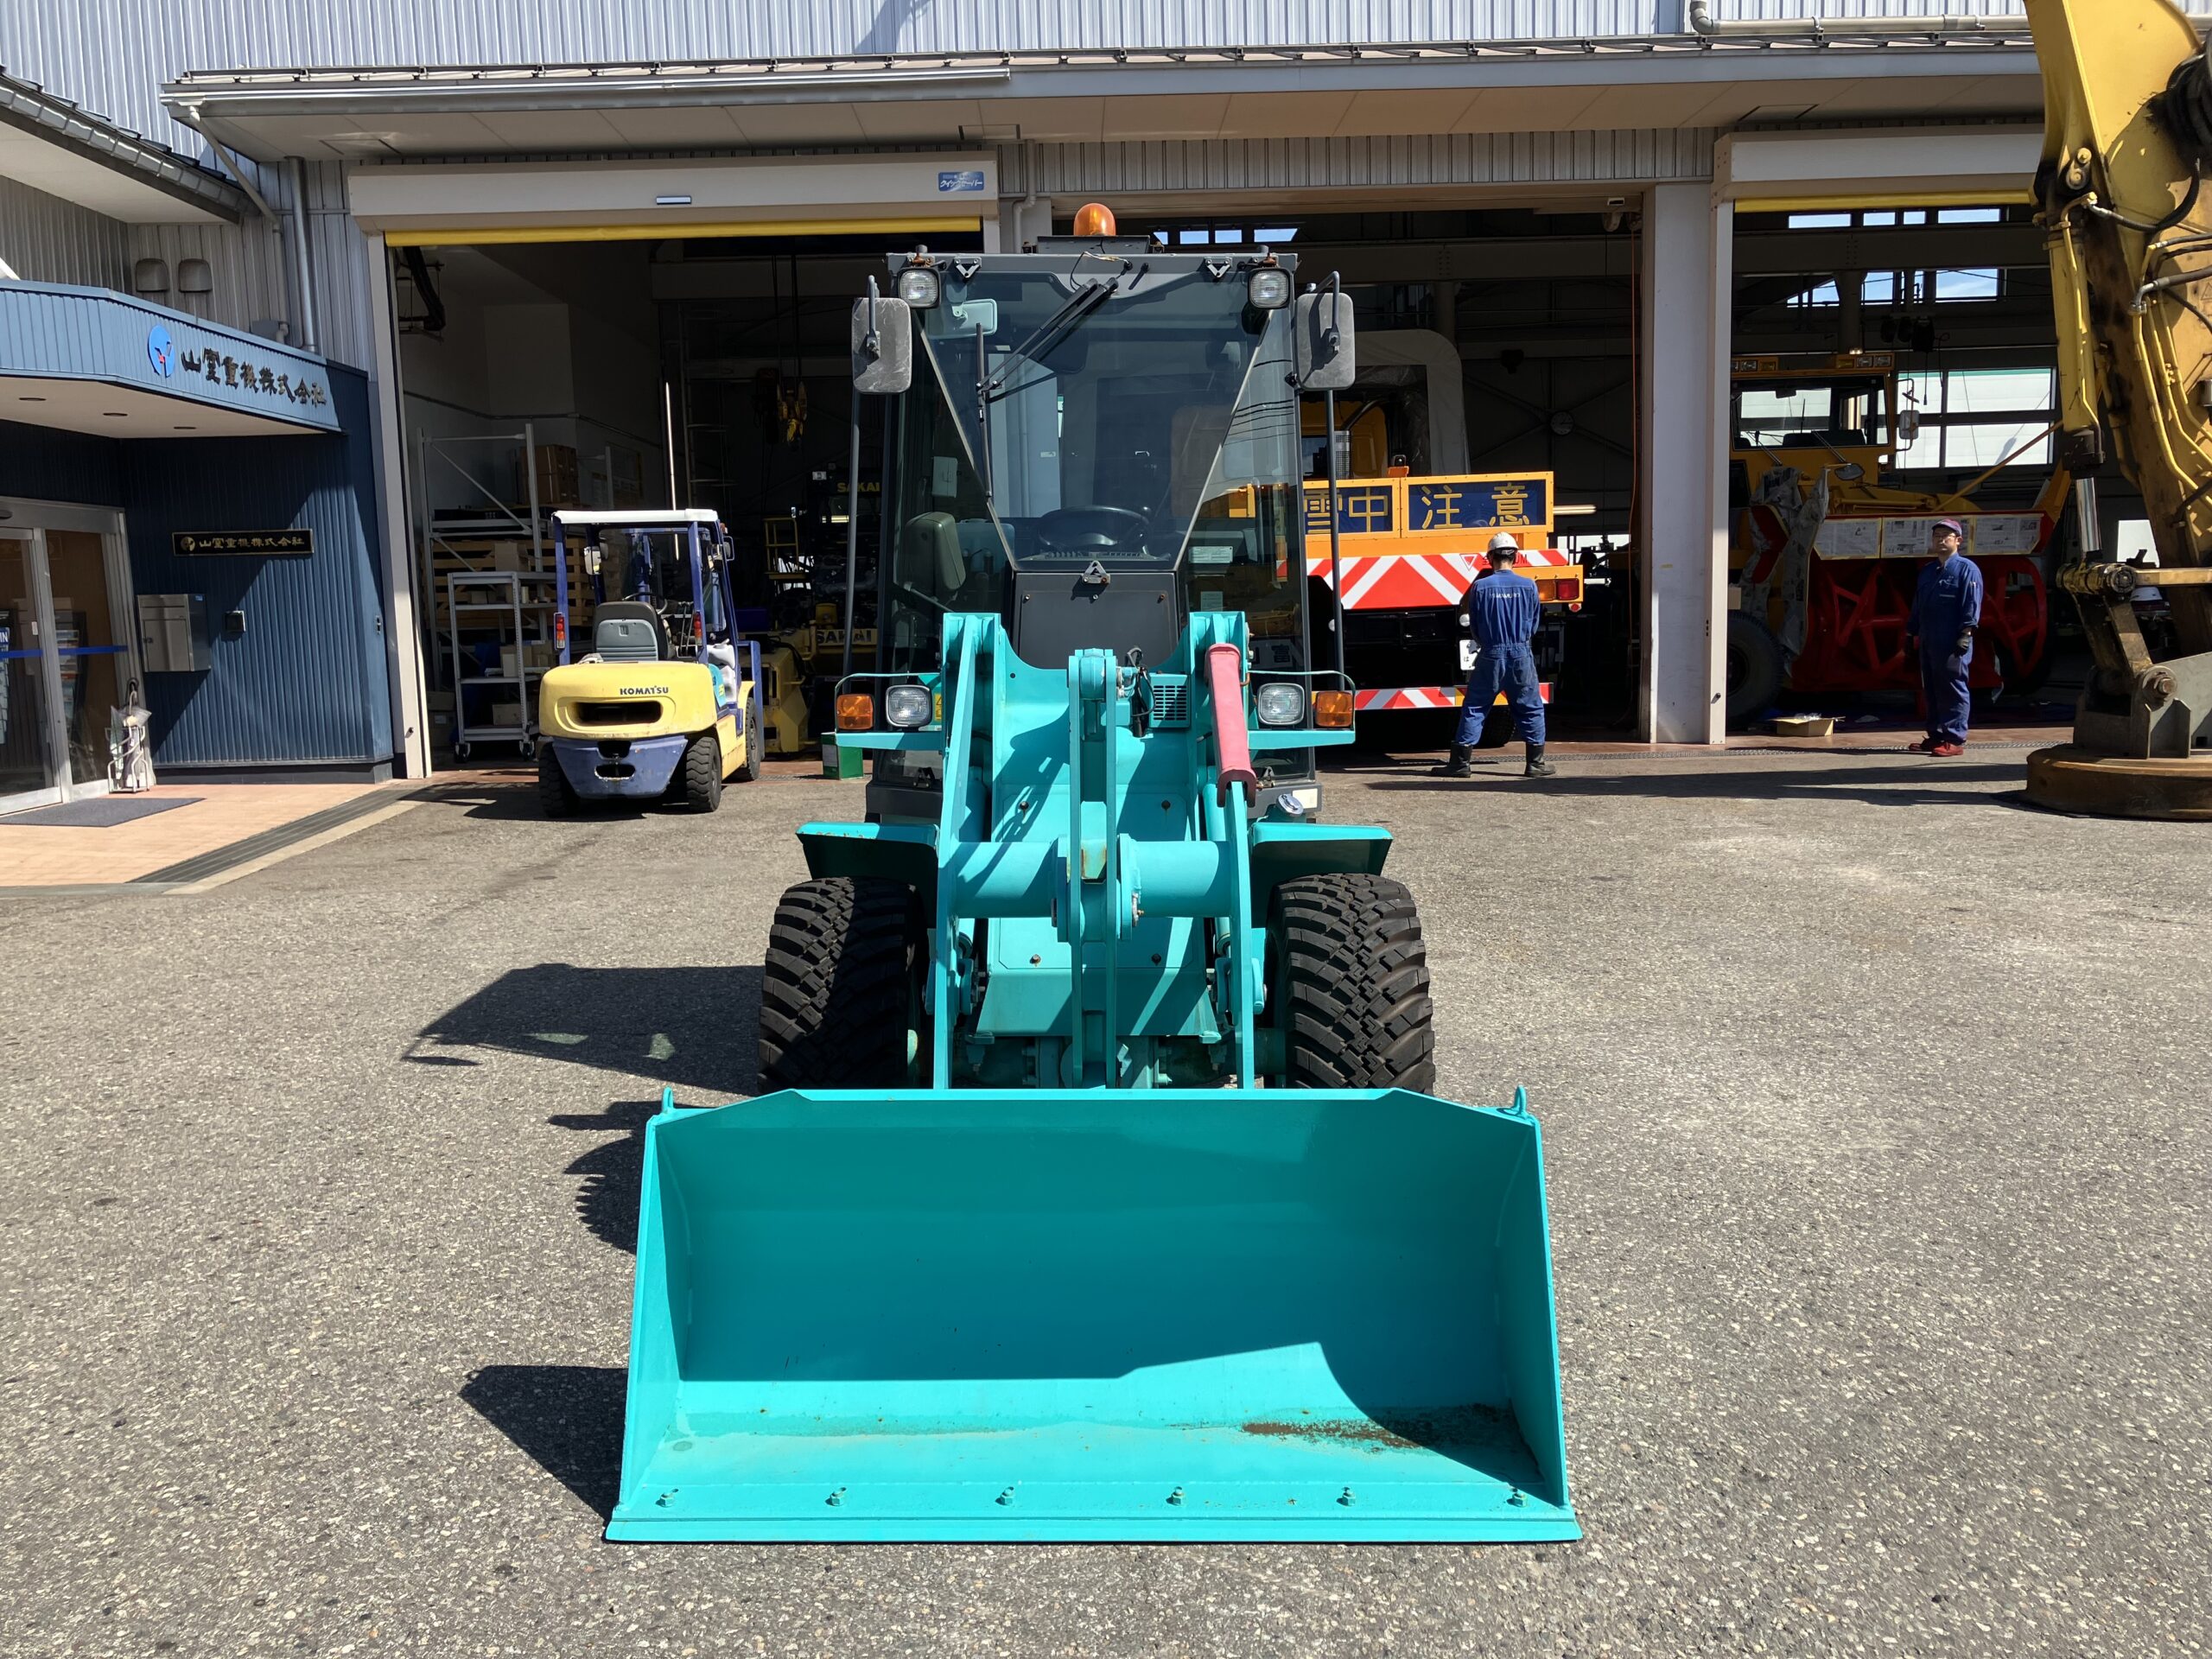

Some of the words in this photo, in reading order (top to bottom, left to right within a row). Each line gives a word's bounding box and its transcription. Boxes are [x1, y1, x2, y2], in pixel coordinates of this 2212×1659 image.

[181, 347, 327, 407] 山室重機株式会社
[837, 482, 880, 493] SKAI
[1421, 482, 1529, 529] 注意
[620, 685, 669, 696] KOMATSU
